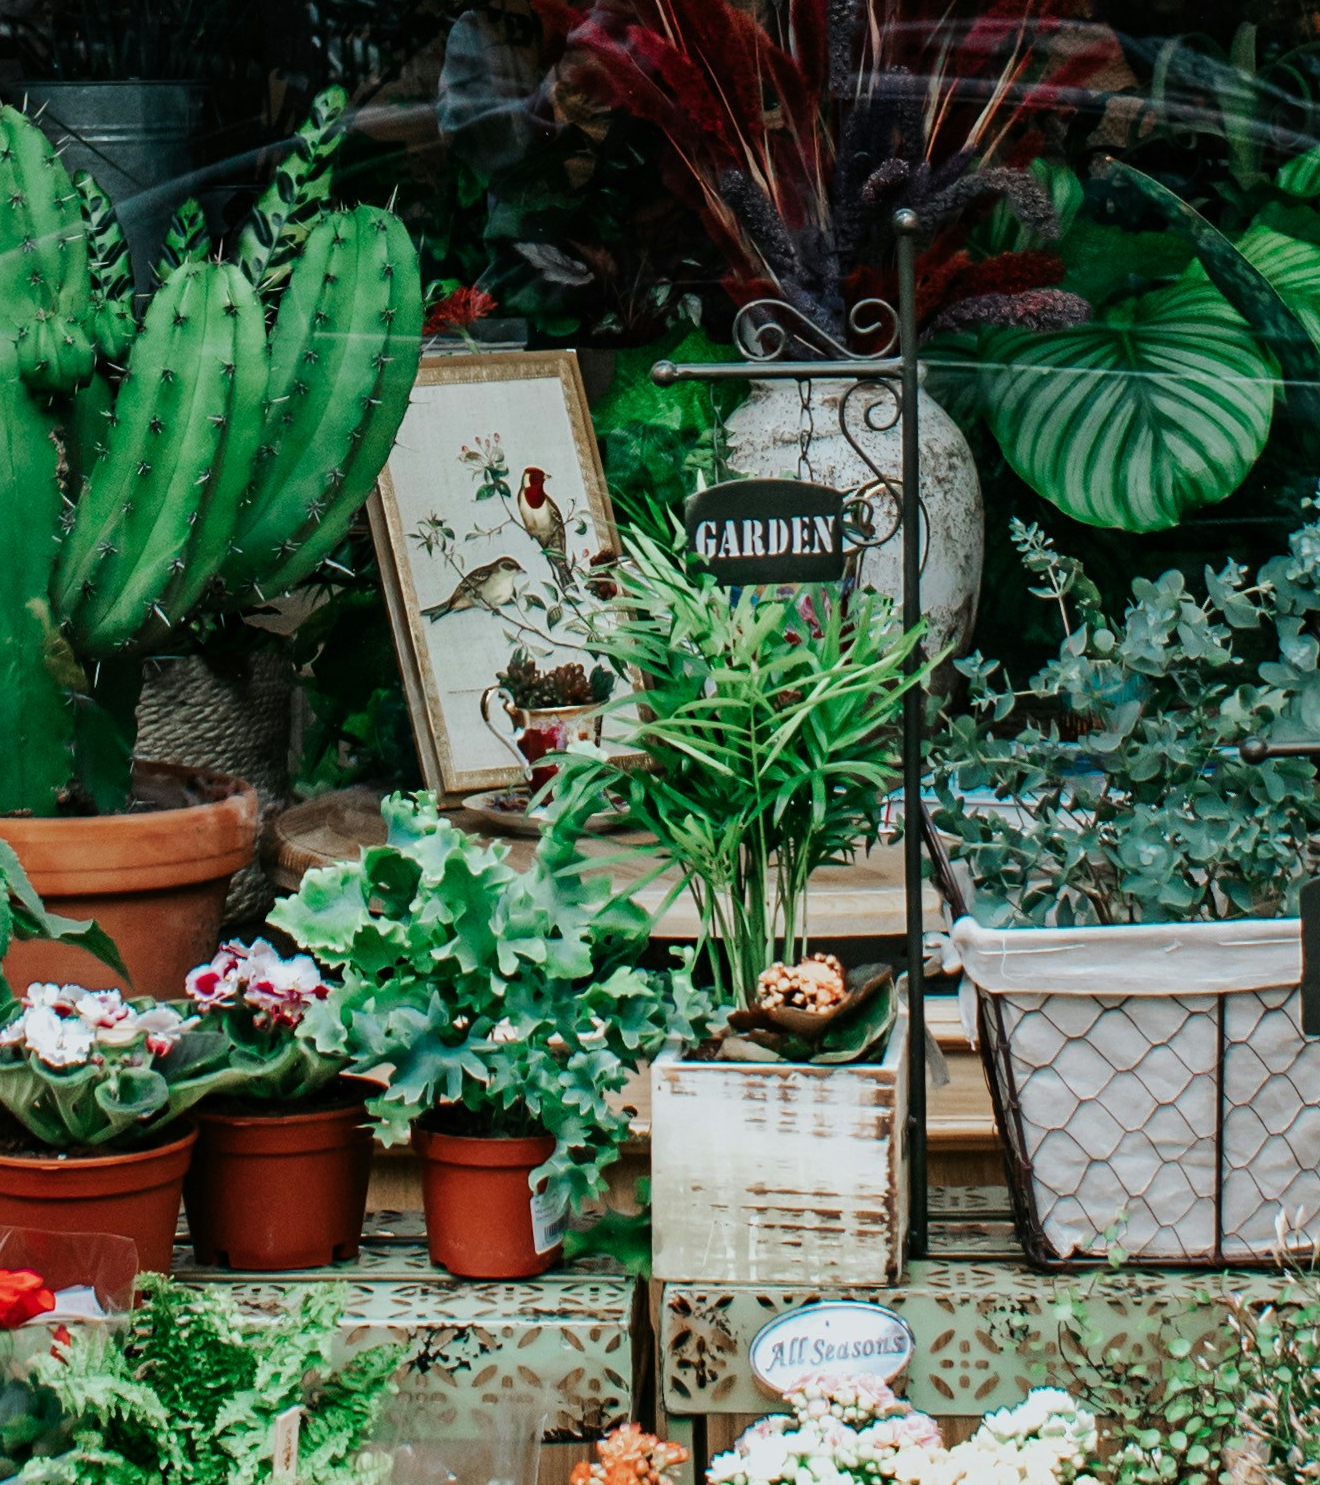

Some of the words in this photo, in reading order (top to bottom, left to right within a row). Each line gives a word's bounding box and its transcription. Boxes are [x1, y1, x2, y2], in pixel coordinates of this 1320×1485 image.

[693, 512, 837, 561] GARDEN
[765, 1336, 809, 1373] All
[810, 1334, 906, 1366] Seasons
